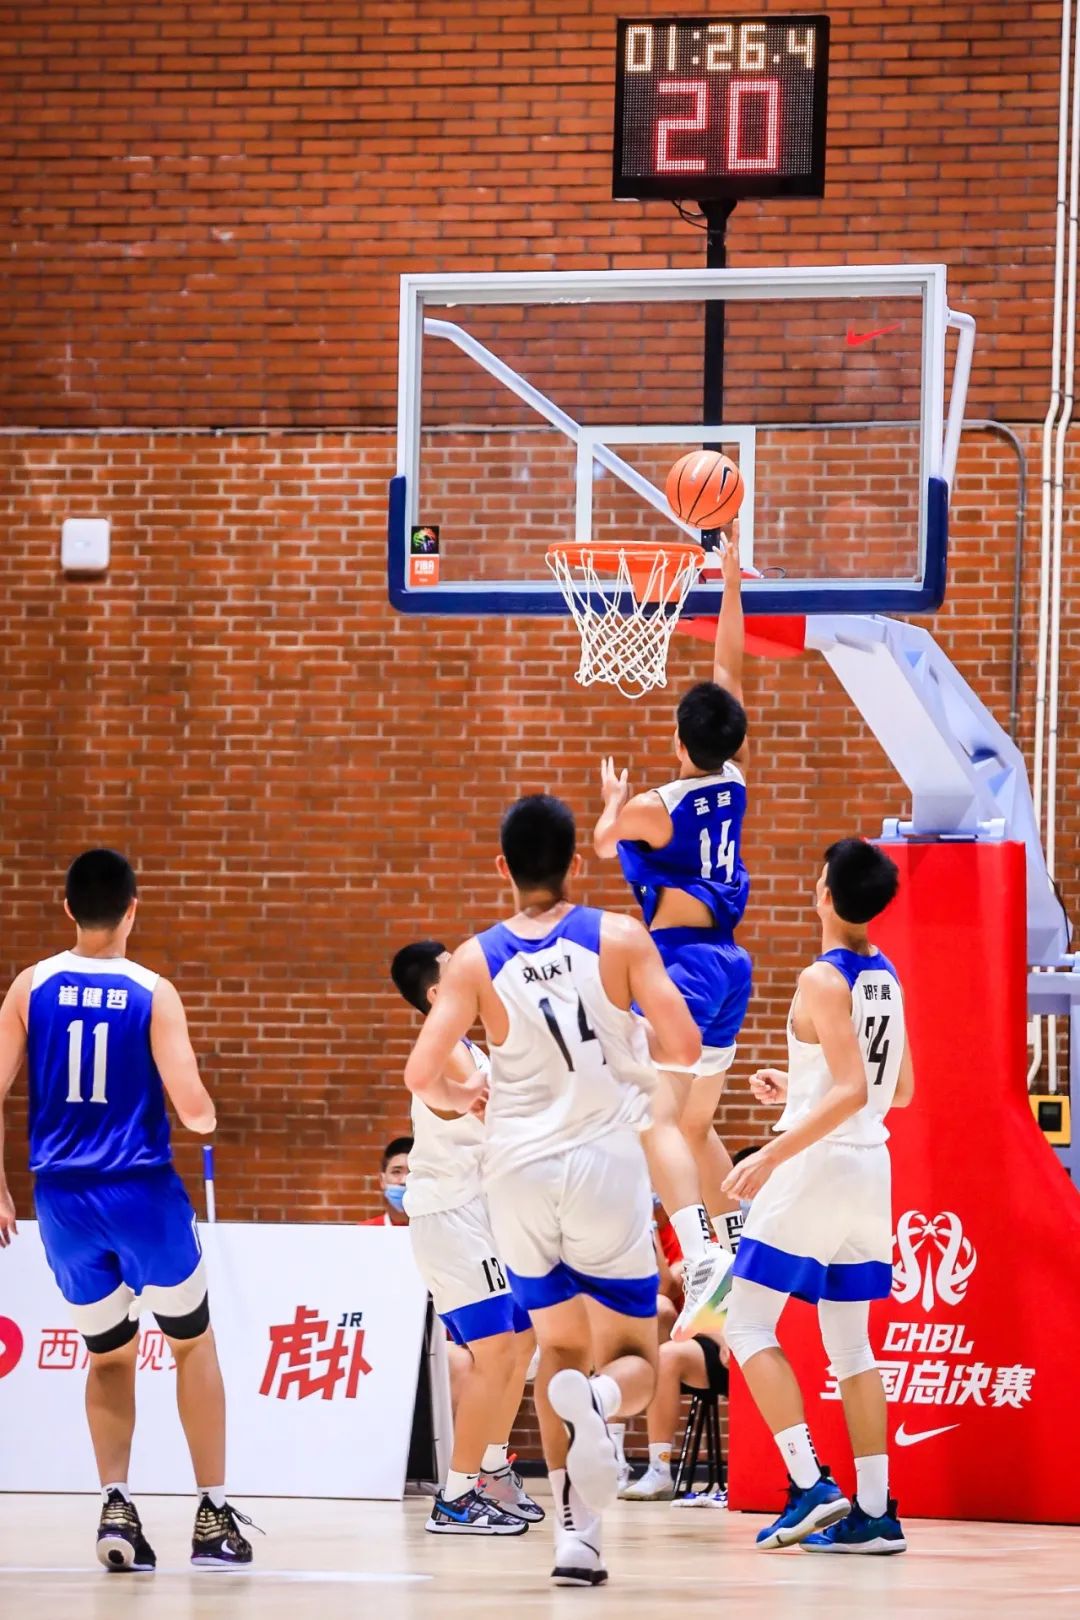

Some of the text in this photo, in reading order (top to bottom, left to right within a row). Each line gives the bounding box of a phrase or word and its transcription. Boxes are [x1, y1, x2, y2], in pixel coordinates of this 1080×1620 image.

[626, 23, 816, 72] 01:26.4
[656, 80, 779, 171] 20
[699, 818, 735, 884] 14
[58, 985, 129, 1010] 崔健哲
[65, 1019, 110, 1104] 11
[481, 1257, 506, 1293] 13
[337, 1311, 364, 1328] JR
[882, 1321, 975, 1355] CHBL
[258, 1304, 374, 1401] 虎扑
